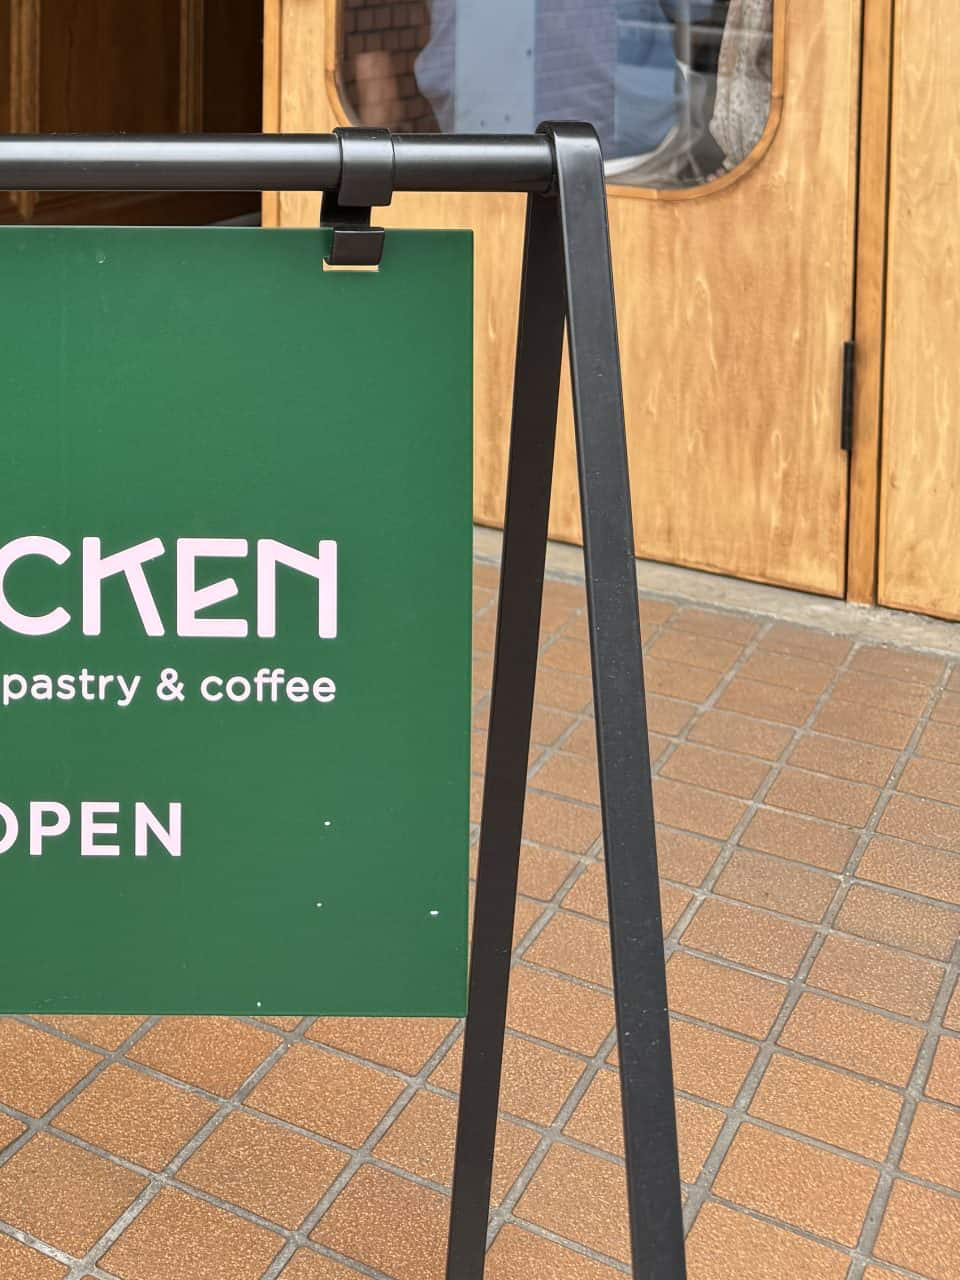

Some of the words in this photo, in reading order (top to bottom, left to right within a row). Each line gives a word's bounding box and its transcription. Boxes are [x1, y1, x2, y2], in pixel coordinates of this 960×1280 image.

[2, 668, 141, 707] pastry
[156, 667, 185, 702] &
[200, 667, 337, 703] coffee
